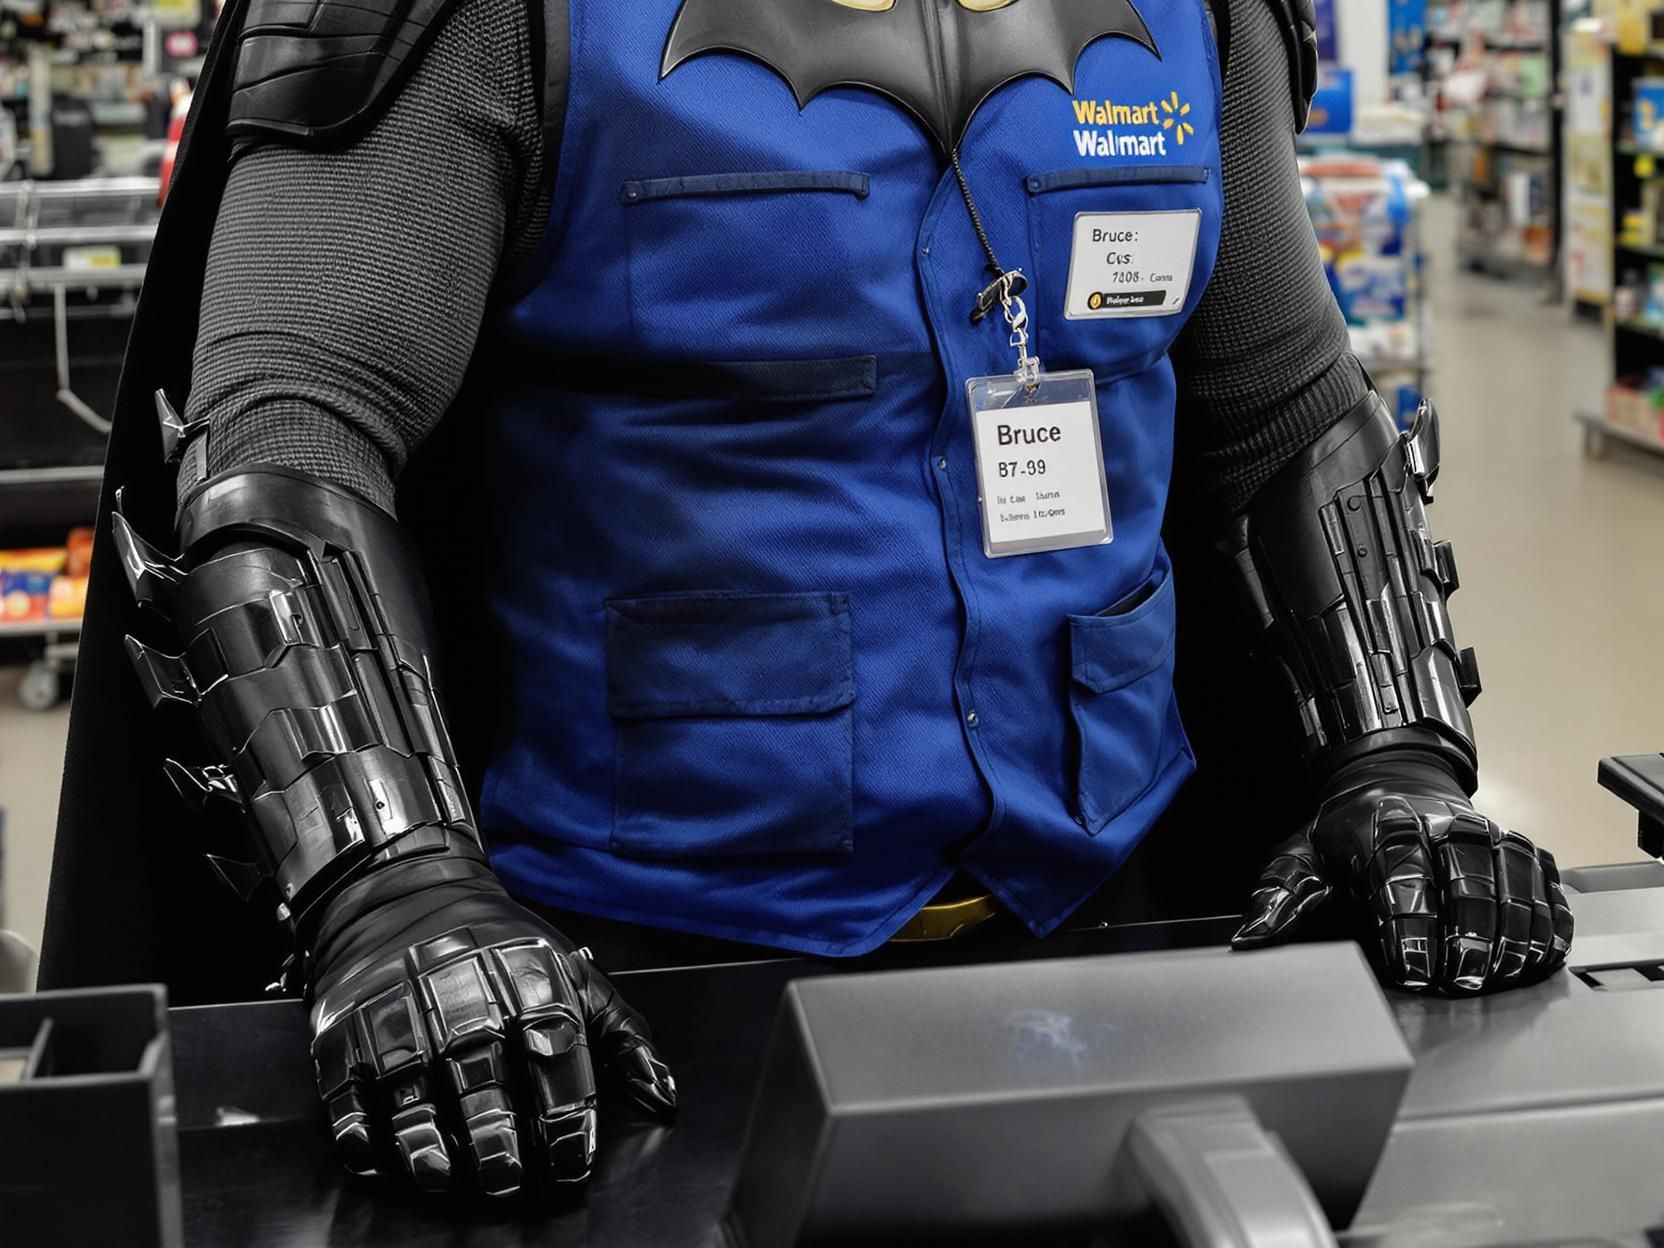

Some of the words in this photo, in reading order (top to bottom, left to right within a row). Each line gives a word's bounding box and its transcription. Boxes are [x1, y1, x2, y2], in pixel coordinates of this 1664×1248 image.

[1072, 99, 1160, 125] Walmart
[1073, 129, 1167, 157] Walmart
[1092, 228, 1139, 243] Bruce:
[997, 424, 1062, 446] Bruce
